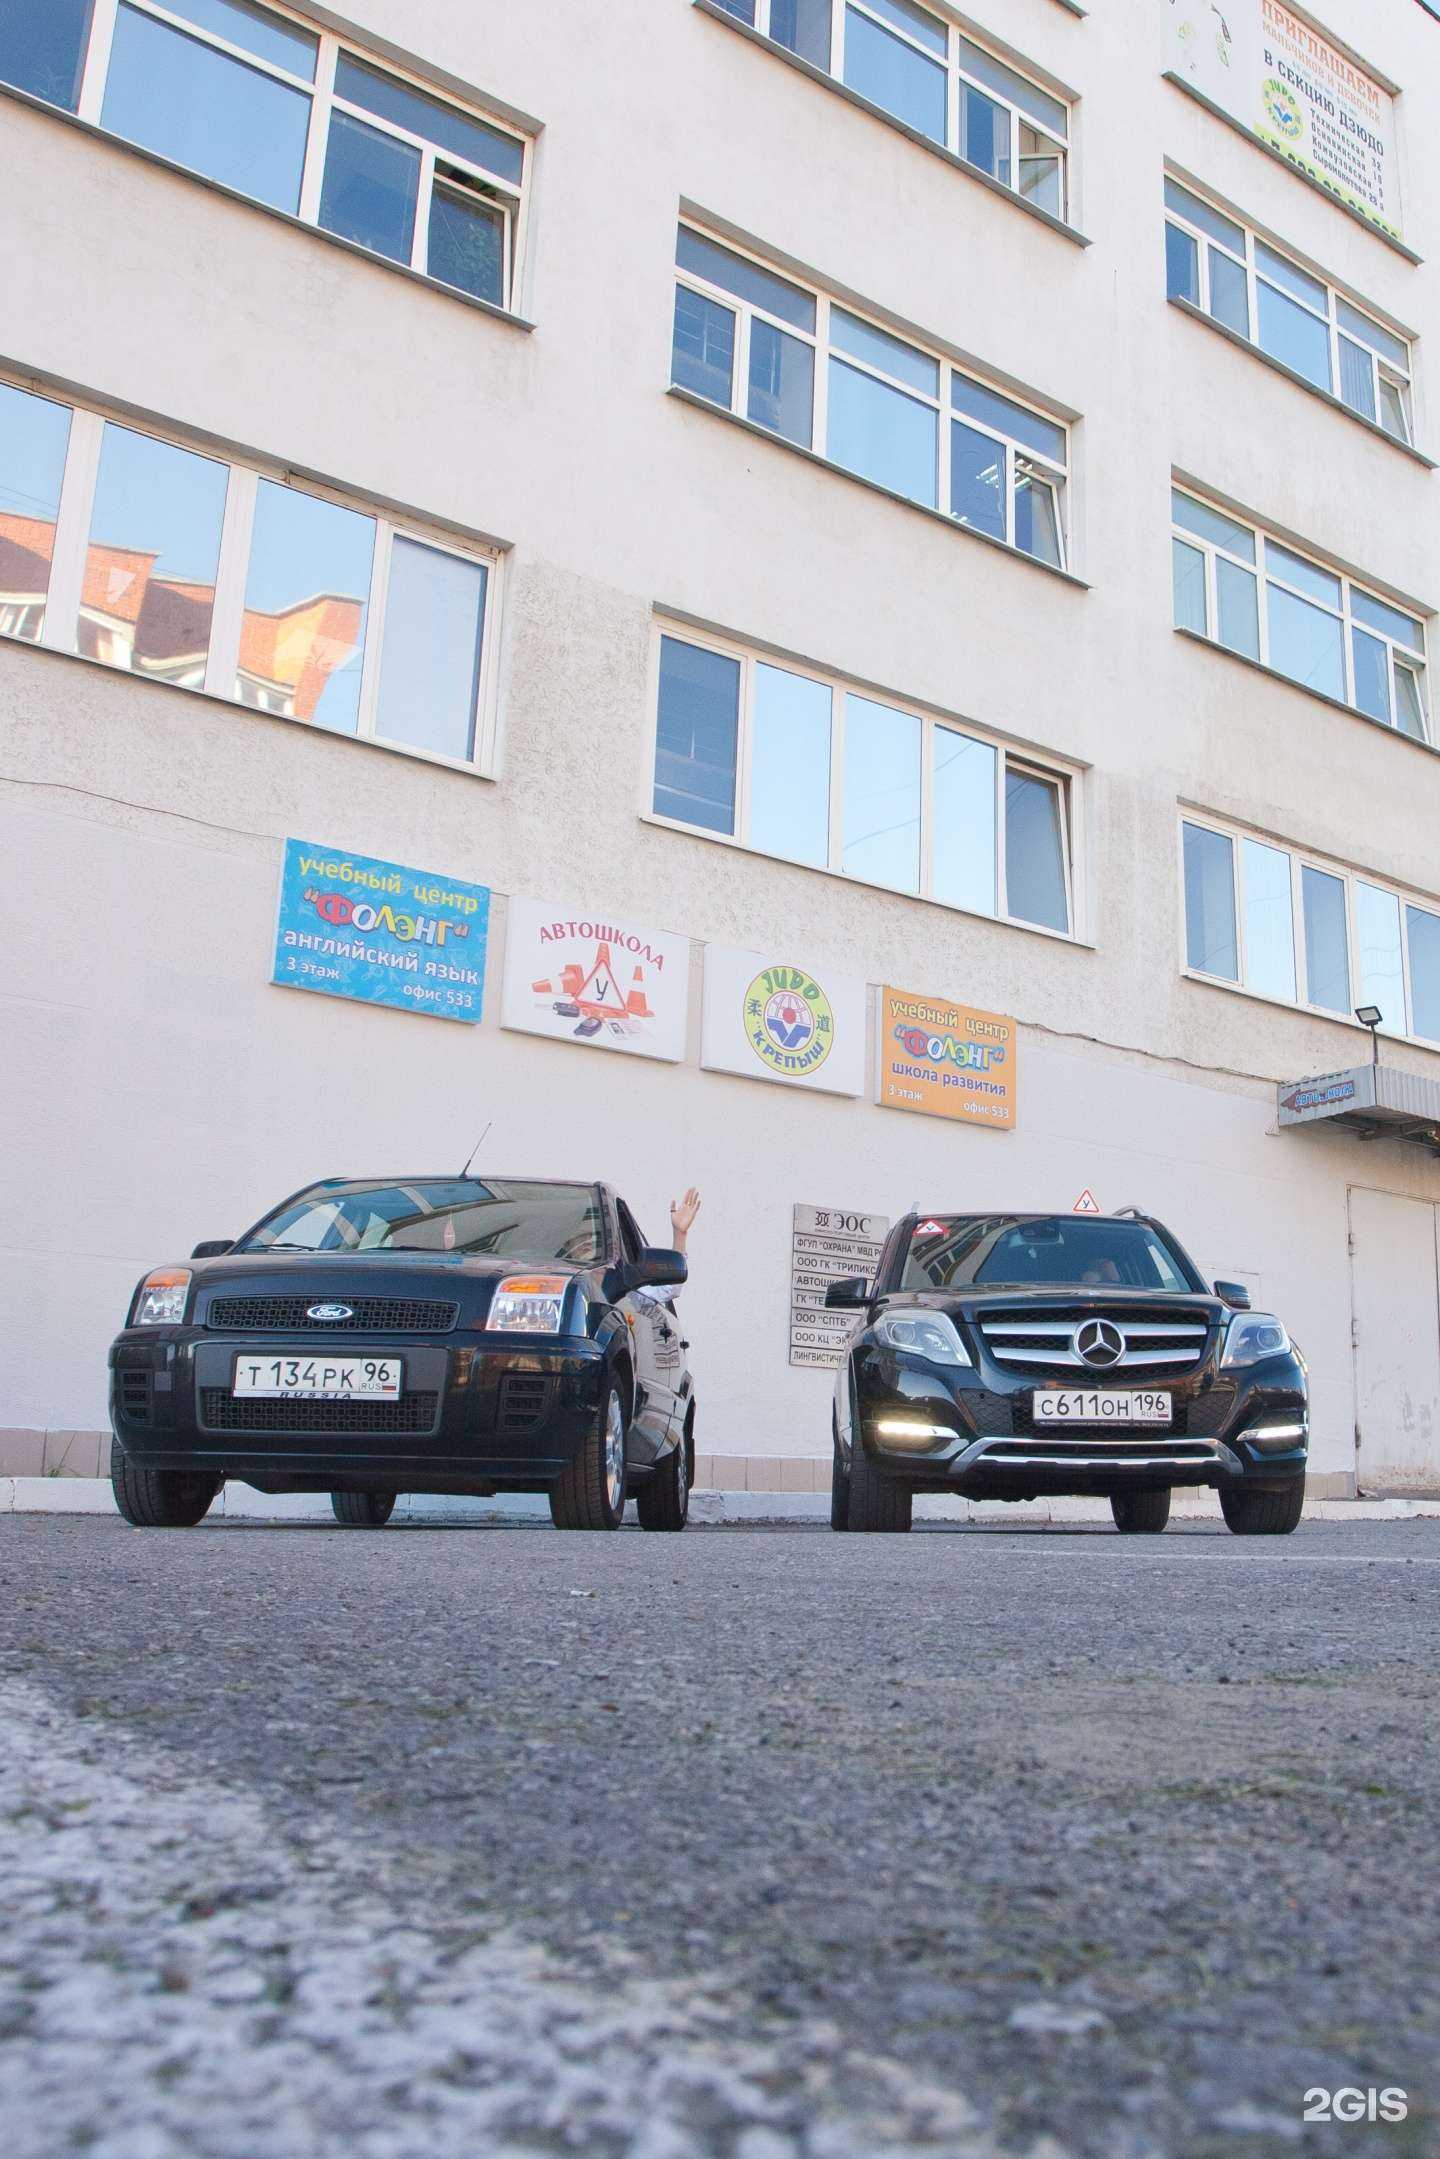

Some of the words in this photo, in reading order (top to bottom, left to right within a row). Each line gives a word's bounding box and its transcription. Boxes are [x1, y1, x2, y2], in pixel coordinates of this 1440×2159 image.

[1262, 1, 1380, 110] ПРИГЛАШАЕМ
[1263, 48, 1273, 67] В
[1278, 60, 1335, 118] СЕКЦИЮ
[1340, 109, 1384, 157] ДЗЮДО
[300, 855, 401, 894] учебный
[414, 885, 479, 915] центр
[539, 921, 665, 971] АВТОШКОЛА
[284, 930, 419, 973] английский
[424, 961, 480, 986] язык
[287, 957, 296, 971] 3
[300, 962, 341, 981] этаж
[403, 985, 442, 1003] офис
[447, 990, 473, 1008] 533
[890, 999, 959, 1028] учебный
[966, 1018, 1009, 1042] центр
[753, 1030, 824, 1068] КРЕПЫШ
[892, 1062, 938, 1082] школа
[943, 1074, 1006, 1097] развития
[888, 1084, 895, 1095] 3
[897, 1087, 922, 1101] этаж
[963, 1101, 989, 1114] офис
[992, 1105, 1009, 1119] 533
[797, 1239, 817, 1248] ФГУП
[820, 1241, 855, 1253] "ОХРАНА"
[857, 1246, 873, 1256] МВД
[797, 1257, 817, 1267] ООО
[820, 1260, 830, 1269] ГК
[796, 1294, 806, 1303] ГК
[796, 1313, 816, 1323] ООО
[795, 1332, 816, 1342] ООО
[817, 1334, 829, 1344] КЦ
[361, 1383, 381, 1391] RUS
[1134, 1394, 1166, 1411] 196
